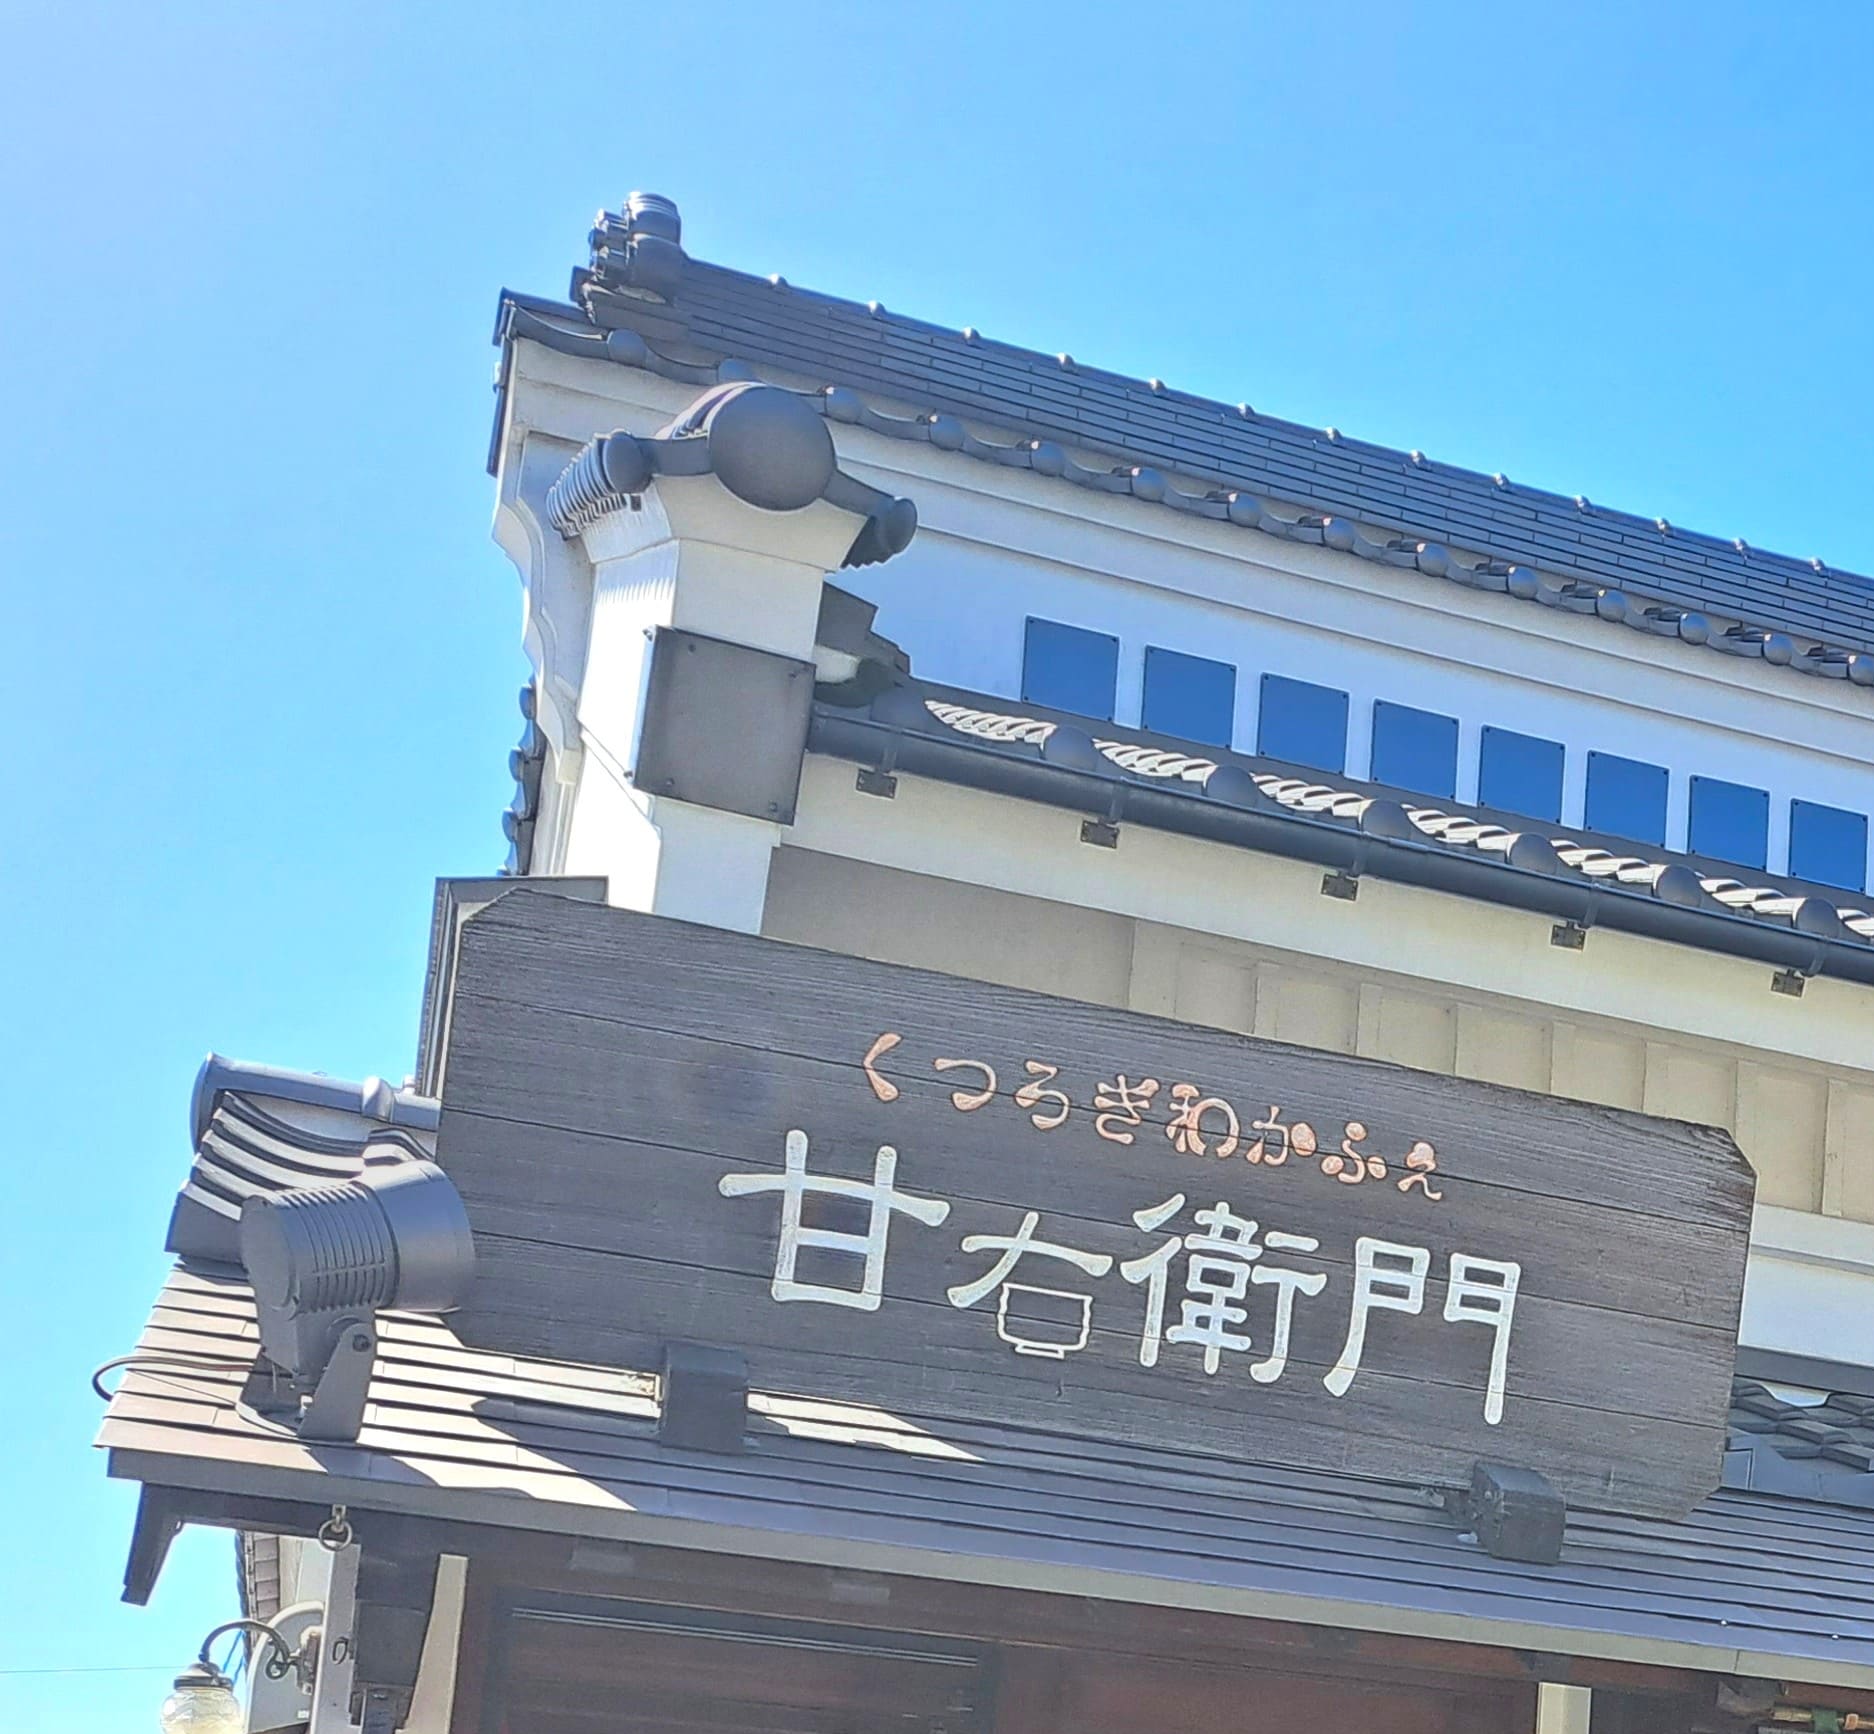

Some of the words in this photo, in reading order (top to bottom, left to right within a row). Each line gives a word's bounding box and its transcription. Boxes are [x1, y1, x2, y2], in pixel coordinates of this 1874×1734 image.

[862, 1031, 1444, 1202] くつろぎ和かふぇ
[718, 1128, 1525, 1427] 甘右衛門
